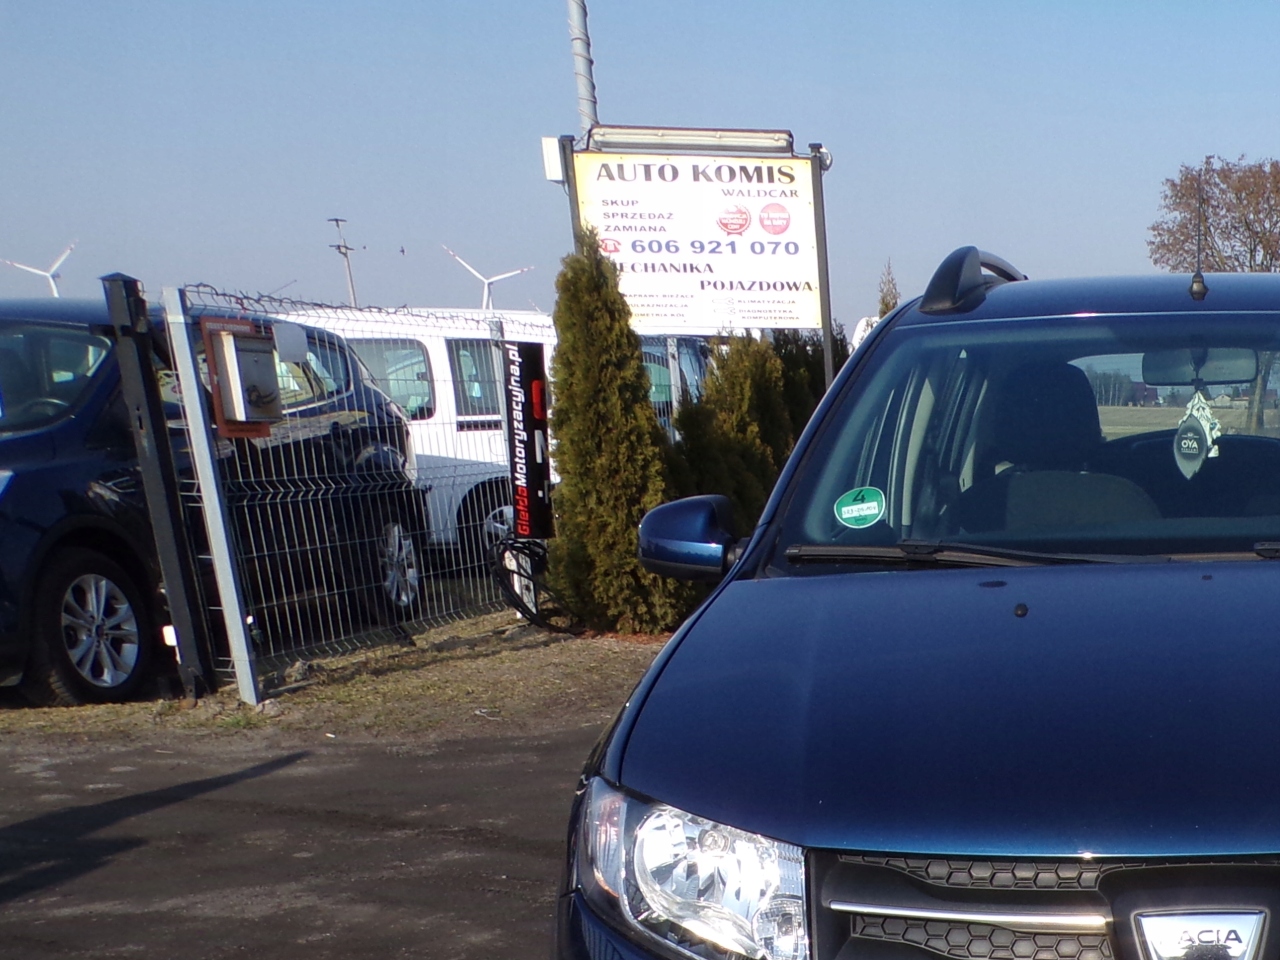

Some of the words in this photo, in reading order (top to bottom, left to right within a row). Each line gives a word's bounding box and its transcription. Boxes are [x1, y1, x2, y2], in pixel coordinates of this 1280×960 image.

[596, 163, 679, 182] AUTO
[692, 164, 796, 185] KOMIS
[721, 188, 799, 198] WALDCAR
[601, 199, 639, 207] SKUP
[602, 211, 674, 220] SPRZEDAŻ
[603, 224, 667, 233] ZAMIANA
[631, 239, 680, 254] 606
[690, 240, 737, 255] 921
[750, 241, 800, 255] 070
[617, 262, 714, 274] ECHANIKA
[700, 280, 813, 292] POJAZDOWA
[852, 489, 866, 503] 4
[1178, 929, 1243, 944] ACIA
